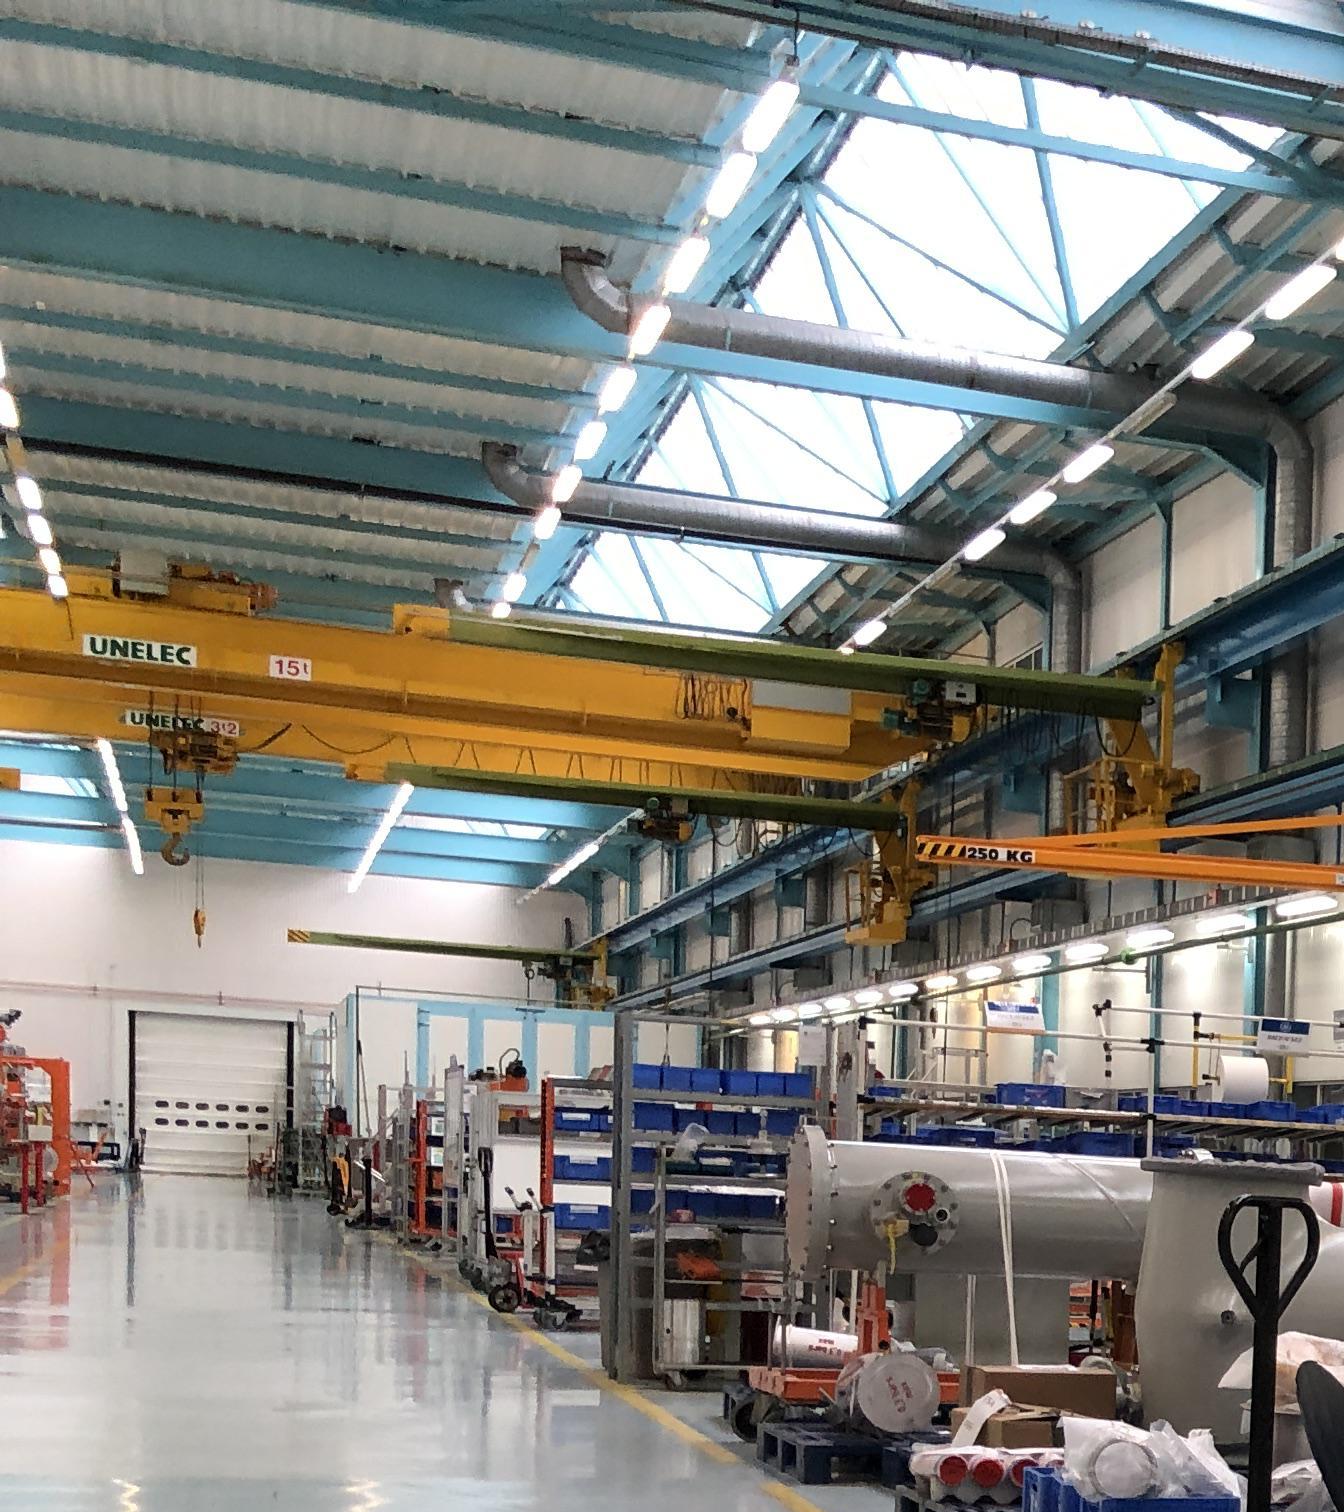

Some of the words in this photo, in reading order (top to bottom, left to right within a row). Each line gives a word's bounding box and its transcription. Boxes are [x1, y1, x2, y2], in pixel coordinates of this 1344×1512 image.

[90, 637, 192, 665] UNELEC
[967, 847, 999, 860] 250
[1006, 850, 1033, 862] KG
